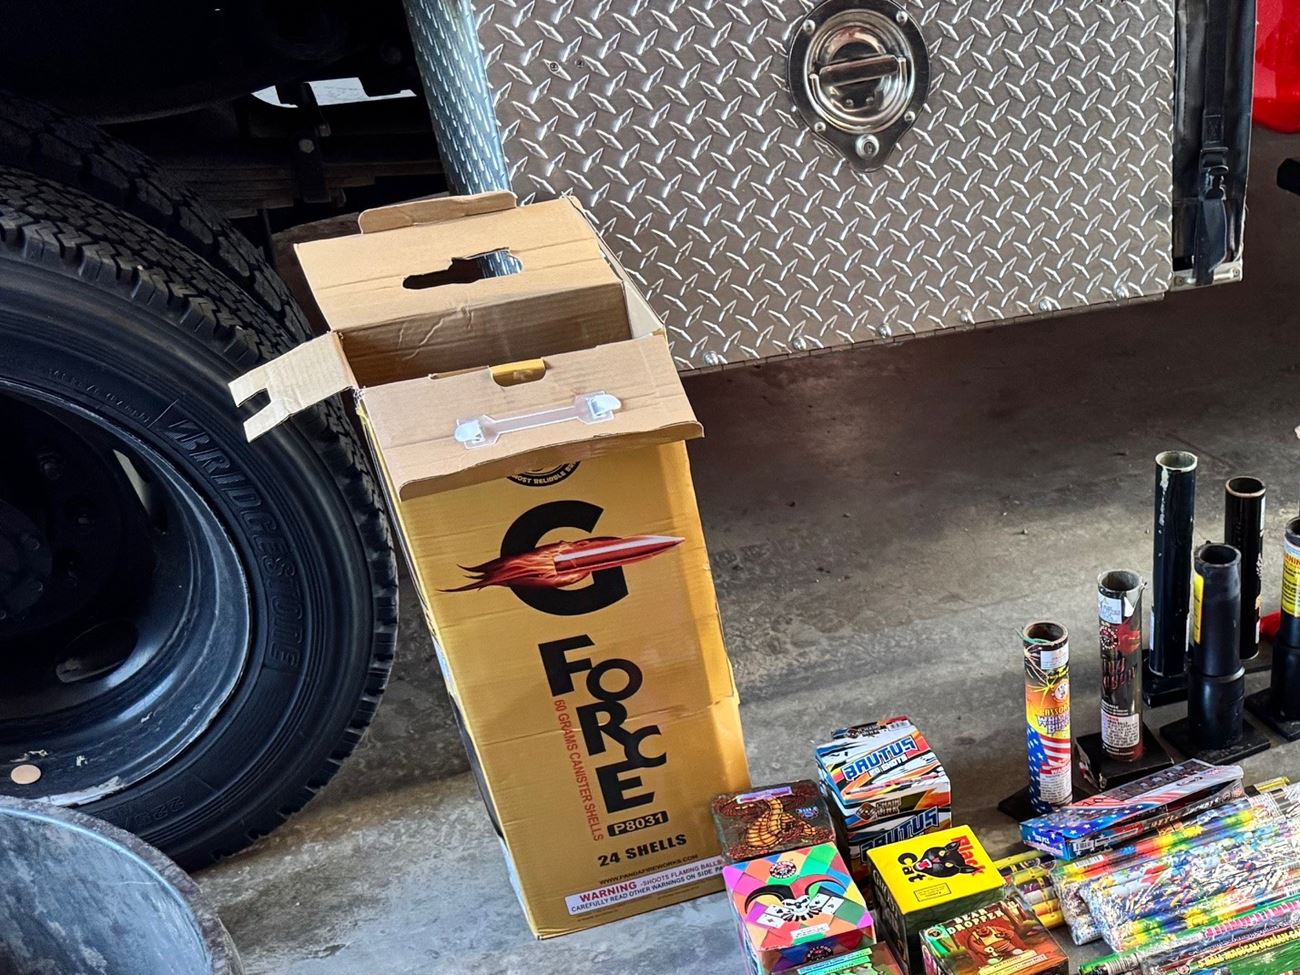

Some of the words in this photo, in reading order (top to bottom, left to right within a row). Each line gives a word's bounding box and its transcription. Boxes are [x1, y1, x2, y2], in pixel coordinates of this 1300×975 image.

[500, 499, 629, 617] G
[538, 634, 668, 814] FORCE
[554, 699, 568, 712] 60
[558, 712, 579, 752] GRAMS
[569, 752, 594, 804] CANISTER
[842, 735, 919, 782] BRUTUS
[584, 802, 605, 842] SHELLS
[613, 812, 665, 835] P8031
[598, 852, 621, 867] 24
[625, 834, 688, 860] SHELLS
[898, 852, 926, 882] Cat
[571, 898, 610, 913] CAREFULLY
[609, 892, 628, 906] READ
[628, 886, 652, 898] OTHER
[651, 876, 685, 893] WARNINGS
[697, 868, 713, 878] SIDE
[579, 881, 638, 903] WARNING
[670, 865, 700, 880] FLAMING
[945, 910, 1006, 935] DROPPER
[955, 907, 988, 925] BEAR
